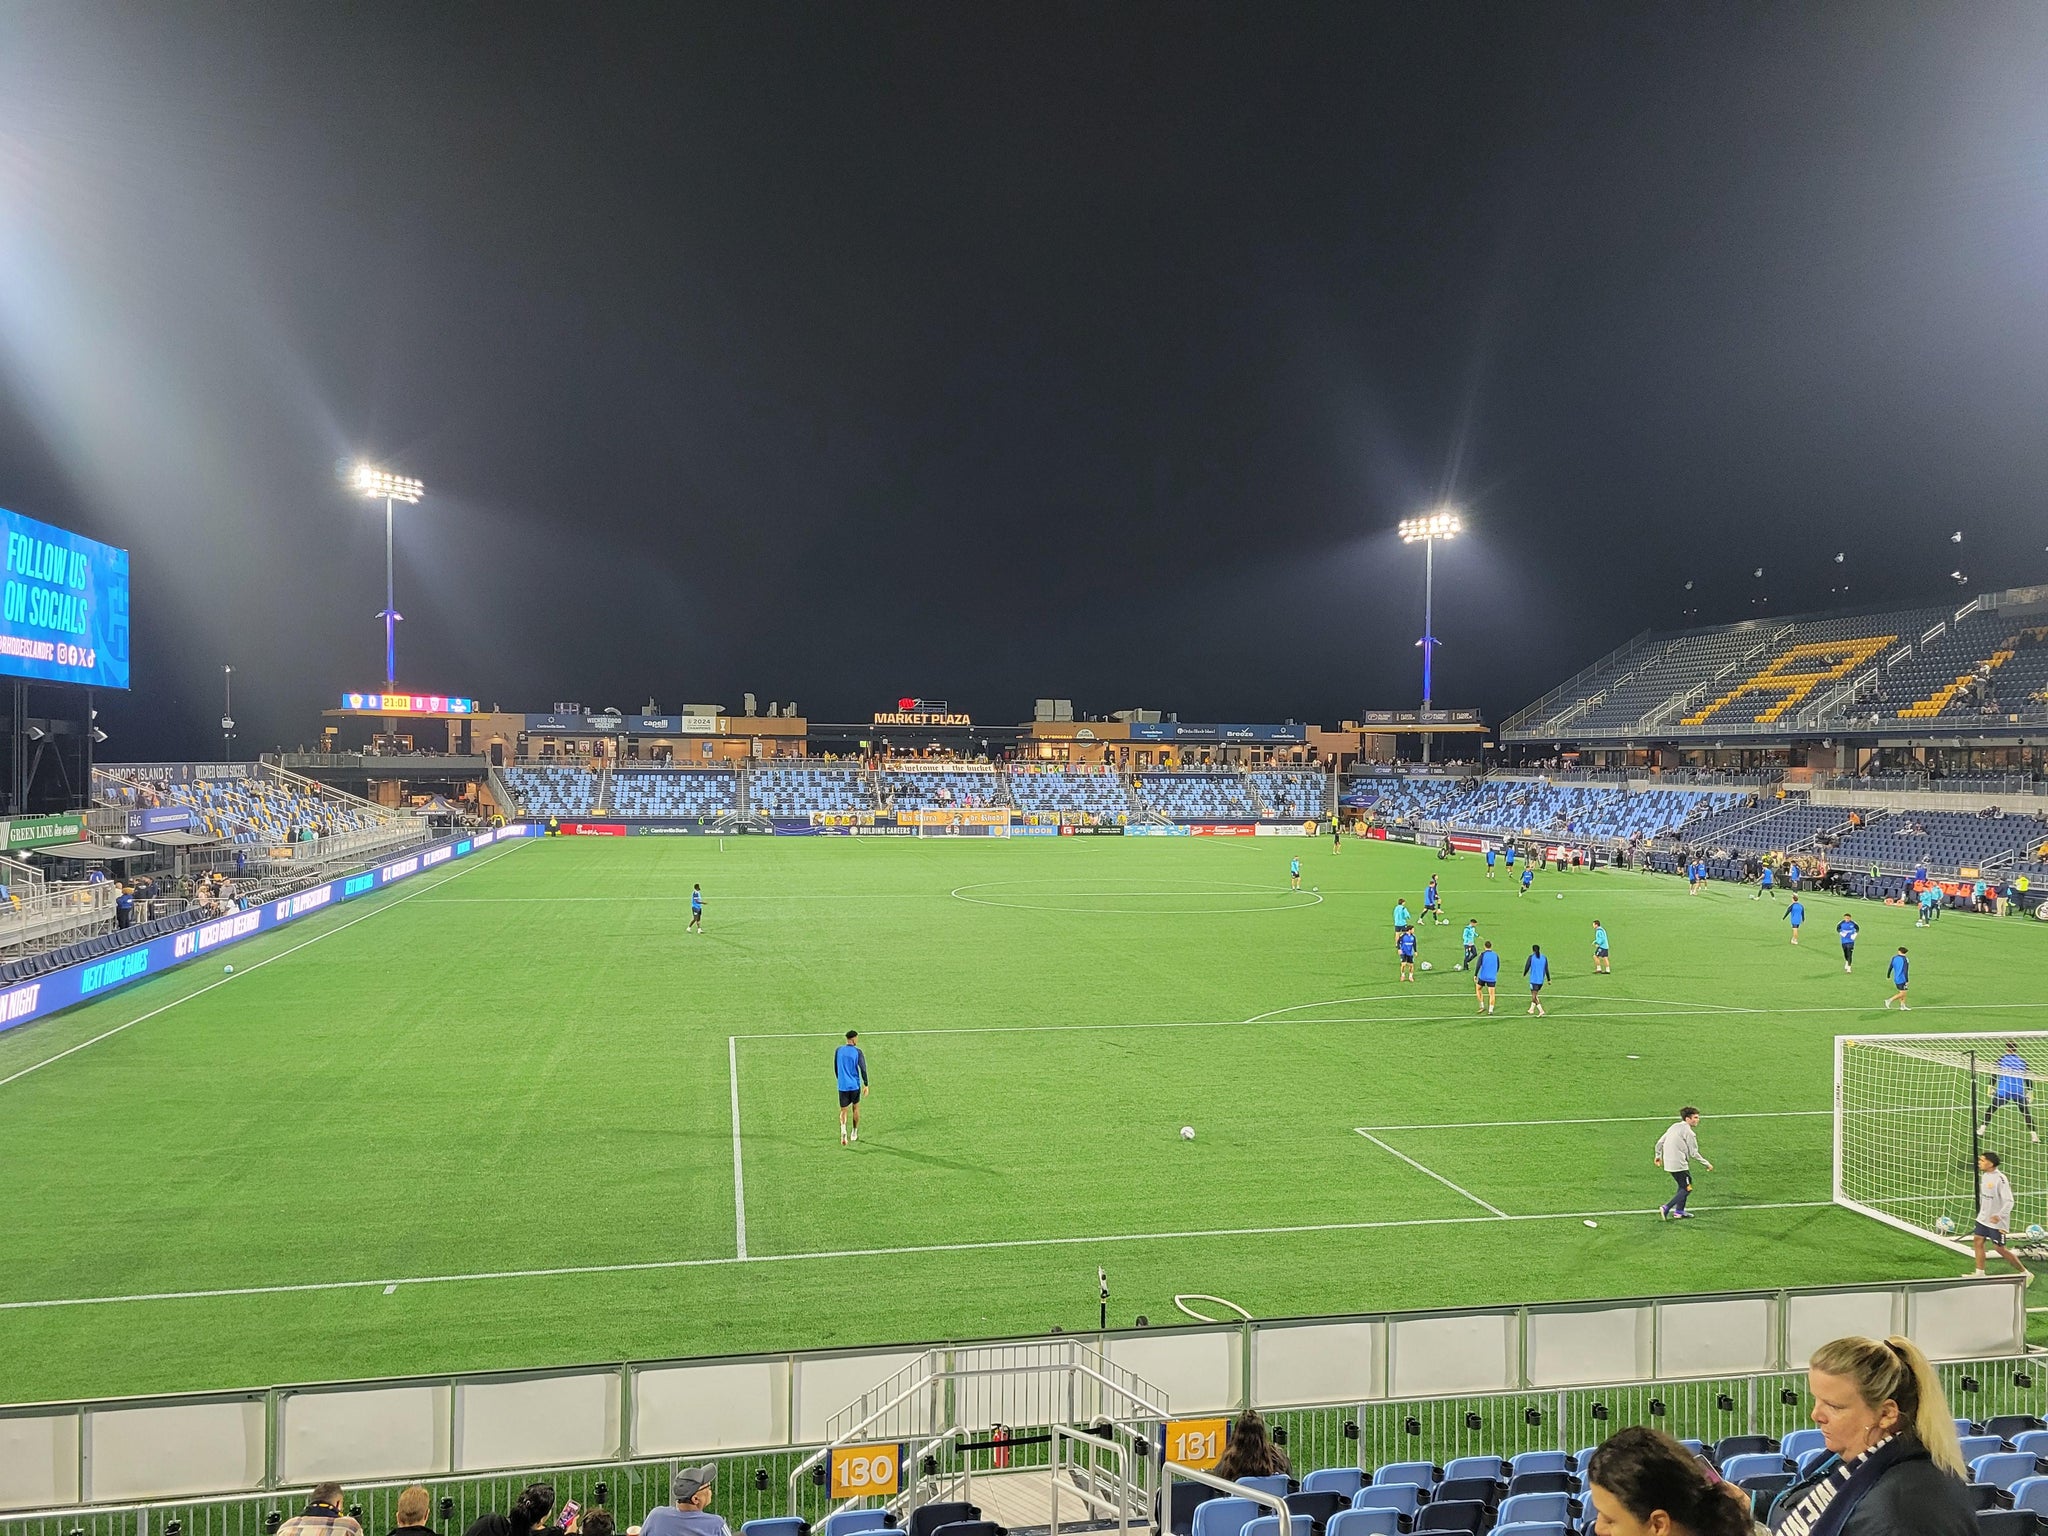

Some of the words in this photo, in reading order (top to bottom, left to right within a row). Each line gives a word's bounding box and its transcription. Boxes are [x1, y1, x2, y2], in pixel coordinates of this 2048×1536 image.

[6, 531, 68, 585] FOLLOW
[69, 551, 88, 591] US
[3, 580, 27, 623] ON
[29, 586, 88, 635] SOCIALS
[383, 698, 407, 707] 21:01
[874, 713, 928, 724] MARKET
[931, 714, 970, 725] PLAZA
[137, 767, 164, 781] ISLAND
[165, 767, 174, 779] FC
[195, 765, 215, 779] WICKED
[216, 765, 229, 778] GOOD
[229, 764, 248, 777] SOCCER
[904, 763, 939, 772] welcome
[952, 763, 964, 771] the
[967, 763, 992, 771] bucket
[10, 826, 35, 842] GREEN
[36, 824, 53, 839] LINE
[860, 827, 885, 835] BUILDING
[886, 827, 911, 835] CAREERS
[81, 964, 105, 994] NEXT
[103, 956, 125, 985] HOME
[124, 948, 149, 978] GAMES
[7, 983, 41, 1020] NIGHT
[1175, 1430, 1216, 1461] 131
[838, 1455, 893, 1488] 130
